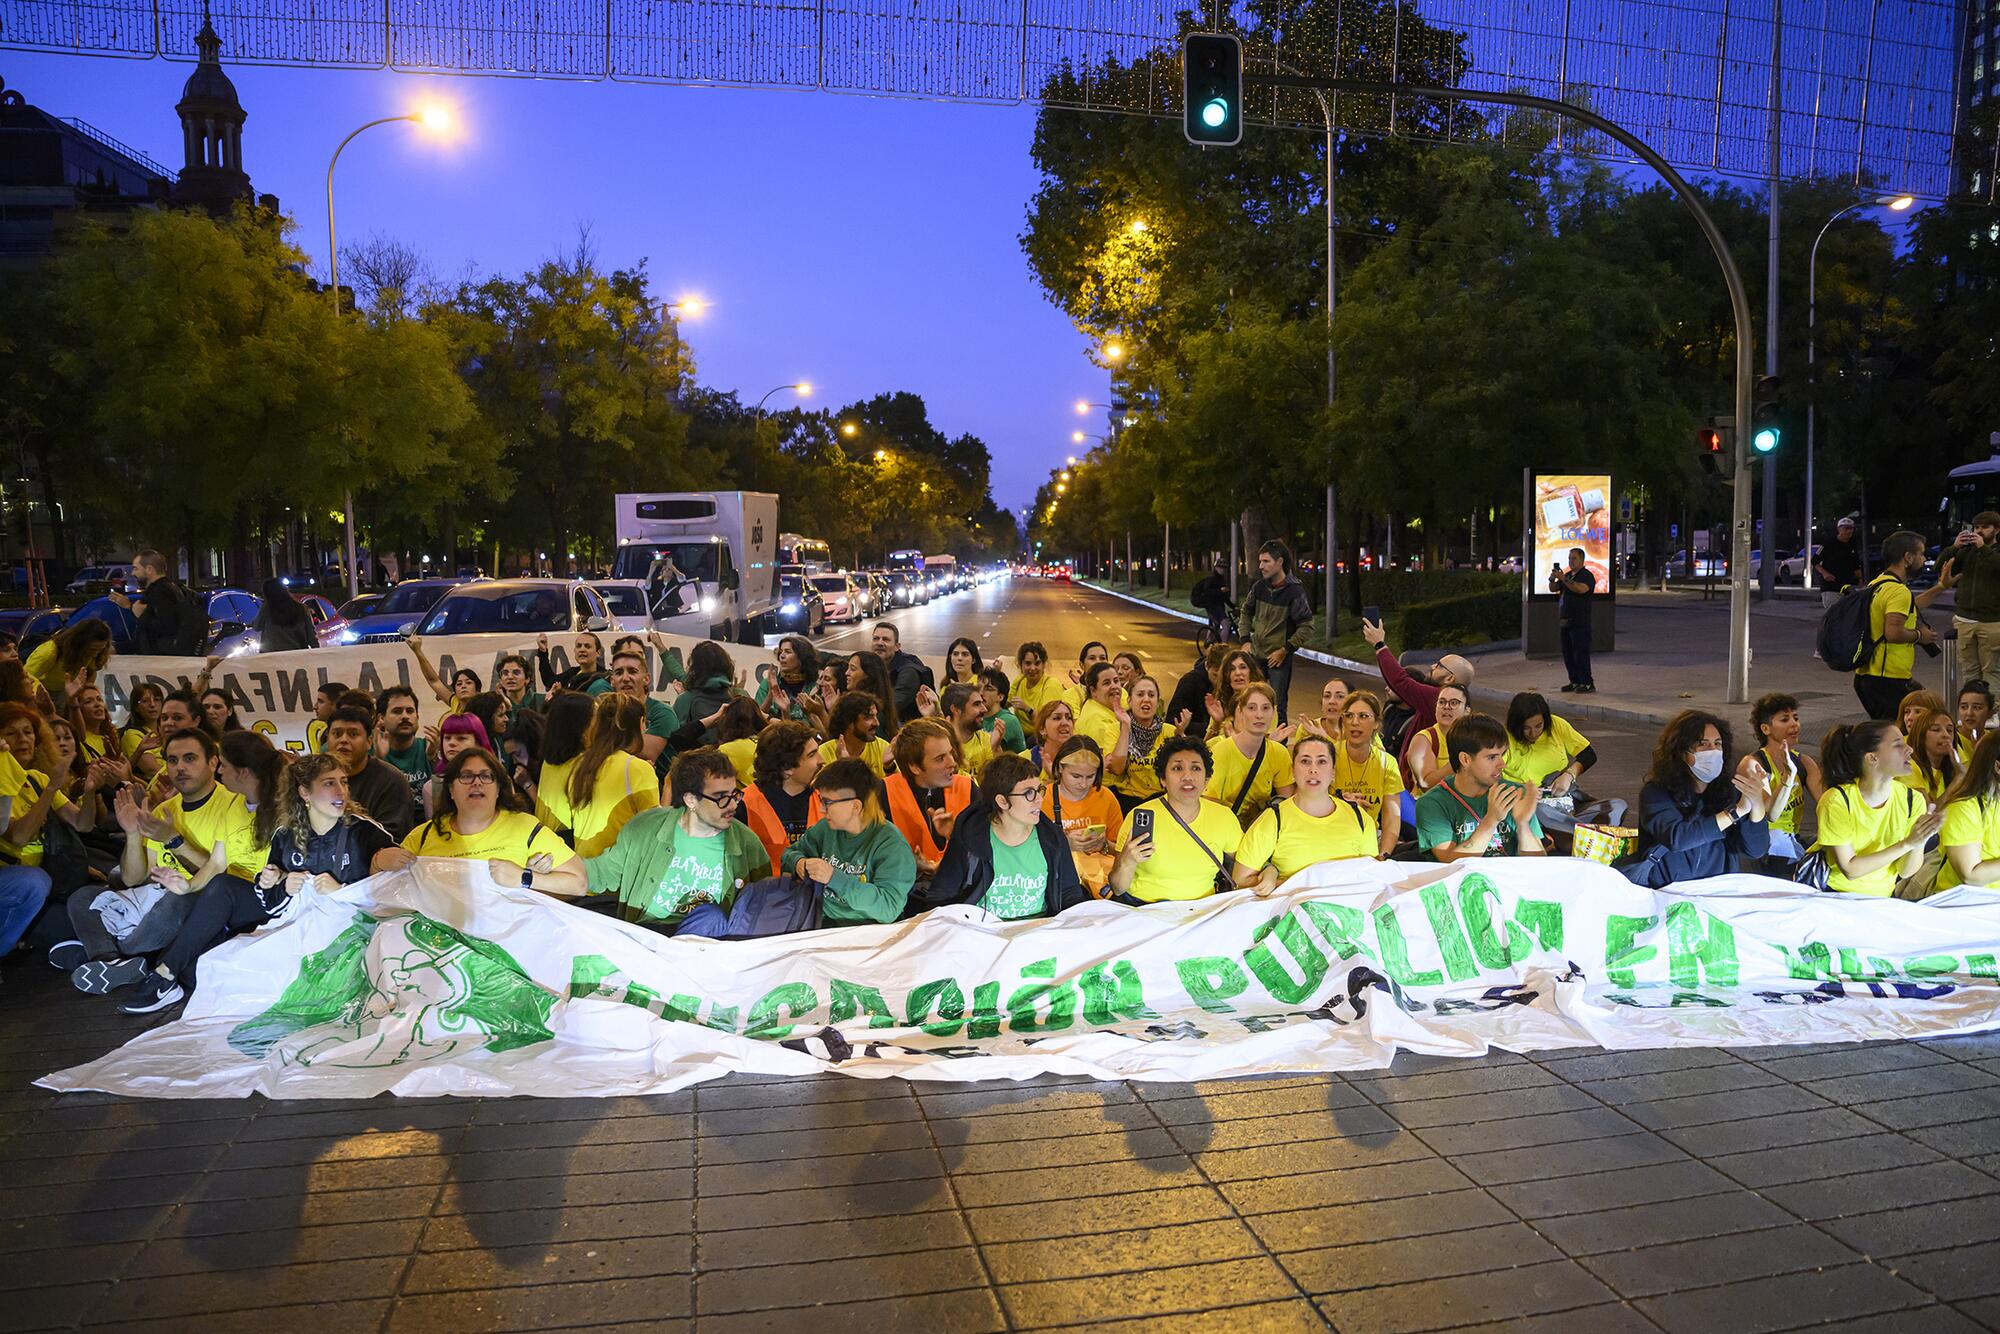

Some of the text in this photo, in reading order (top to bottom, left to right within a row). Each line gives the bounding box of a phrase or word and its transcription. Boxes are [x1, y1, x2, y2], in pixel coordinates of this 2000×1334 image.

[1561, 527, 1607, 541] LOEWE
[1061, 817, 1092, 830] DICATO
[690, 862, 723, 881] PÚBLIC
[569, 954, 1158, 1041] ECACIÓN
